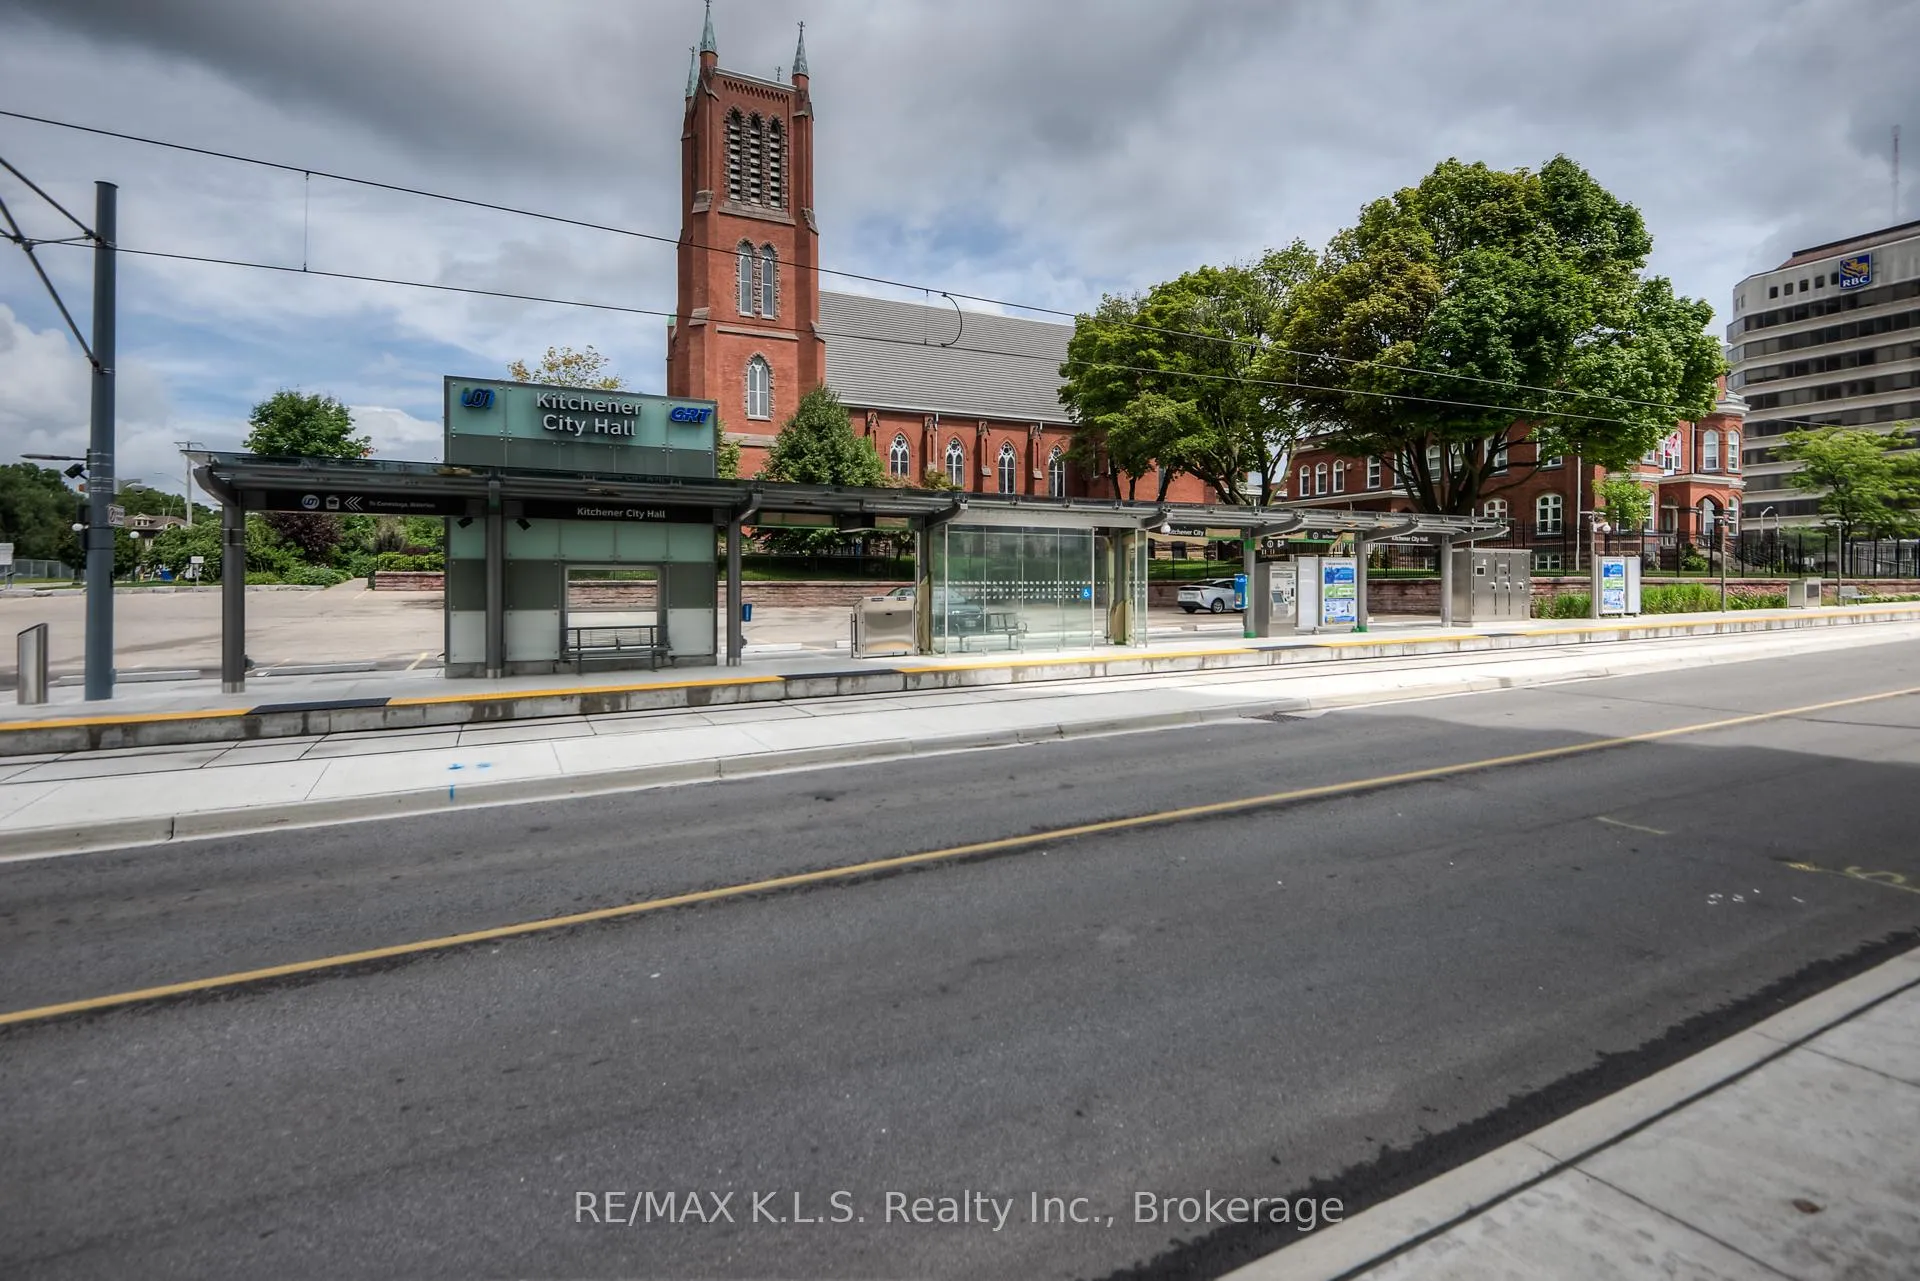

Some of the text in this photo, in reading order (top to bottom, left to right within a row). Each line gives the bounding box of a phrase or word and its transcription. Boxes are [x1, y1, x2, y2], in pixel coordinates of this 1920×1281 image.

[1842, 275, 1868, 287] RBC
[536, 391, 642, 416] Kitchener
[670, 406, 712, 424] GRT
[542, 414, 637, 437] City Hall
[577, 506, 666, 520] Kitchener City Hall
[1193, 529, 1205, 537] City
[1411, 535, 1420, 543] City
